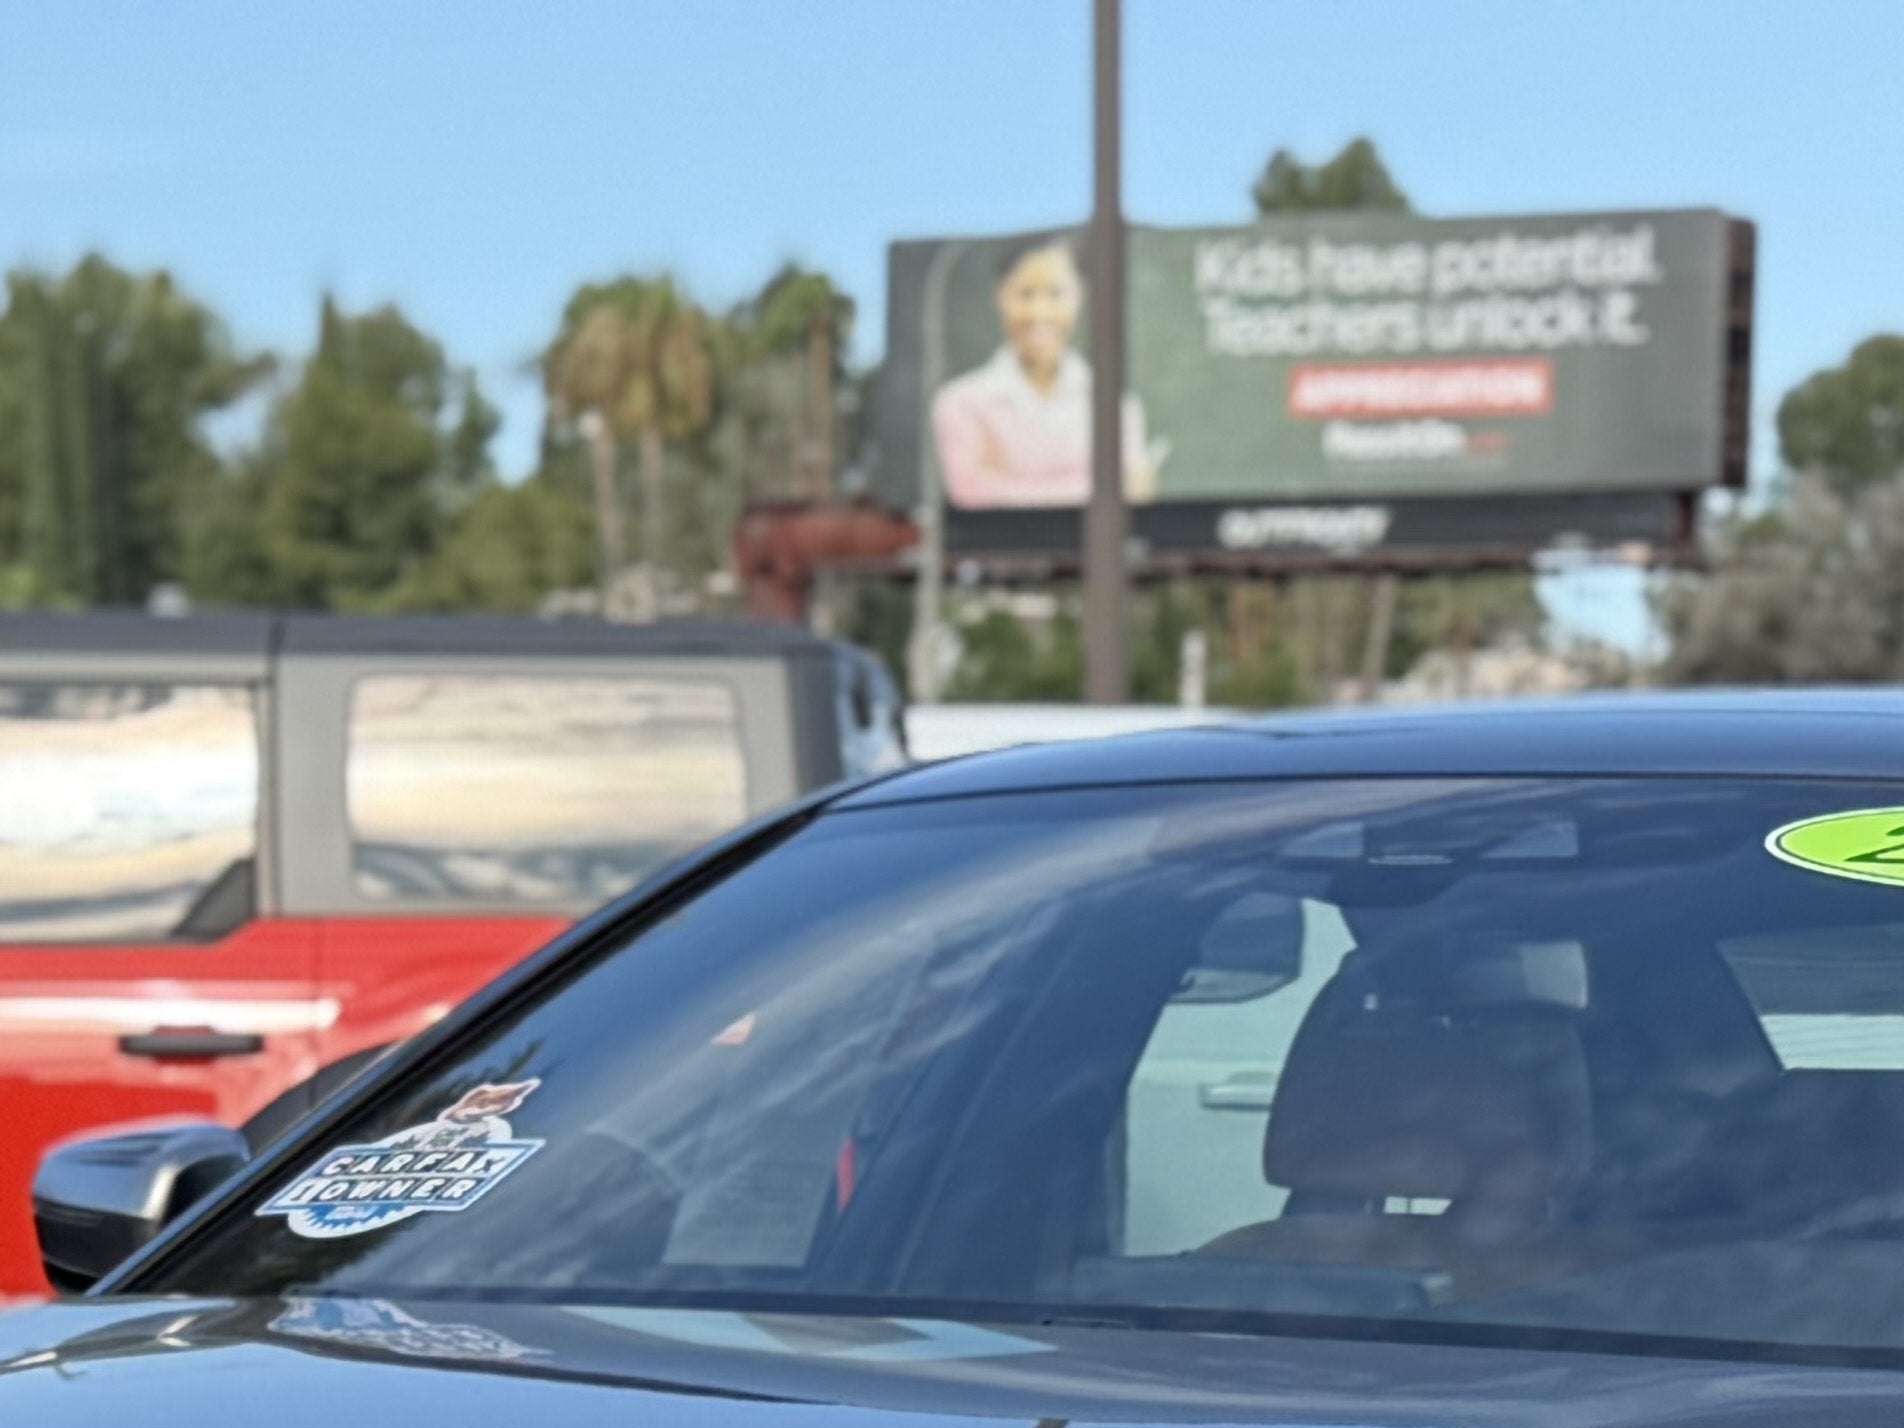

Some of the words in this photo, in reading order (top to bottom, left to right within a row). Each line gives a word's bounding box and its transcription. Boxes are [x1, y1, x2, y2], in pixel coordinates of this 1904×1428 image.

[1198, 238, 1303, 295] Kids
[1307, 235, 1426, 294] have
[1207, 298, 1422, 354] Teachers
[1426, 290, 1592, 350] unlock
[322, 1152, 504, 1175] CARFAX
[319, 1179, 478, 1200] OWNER
